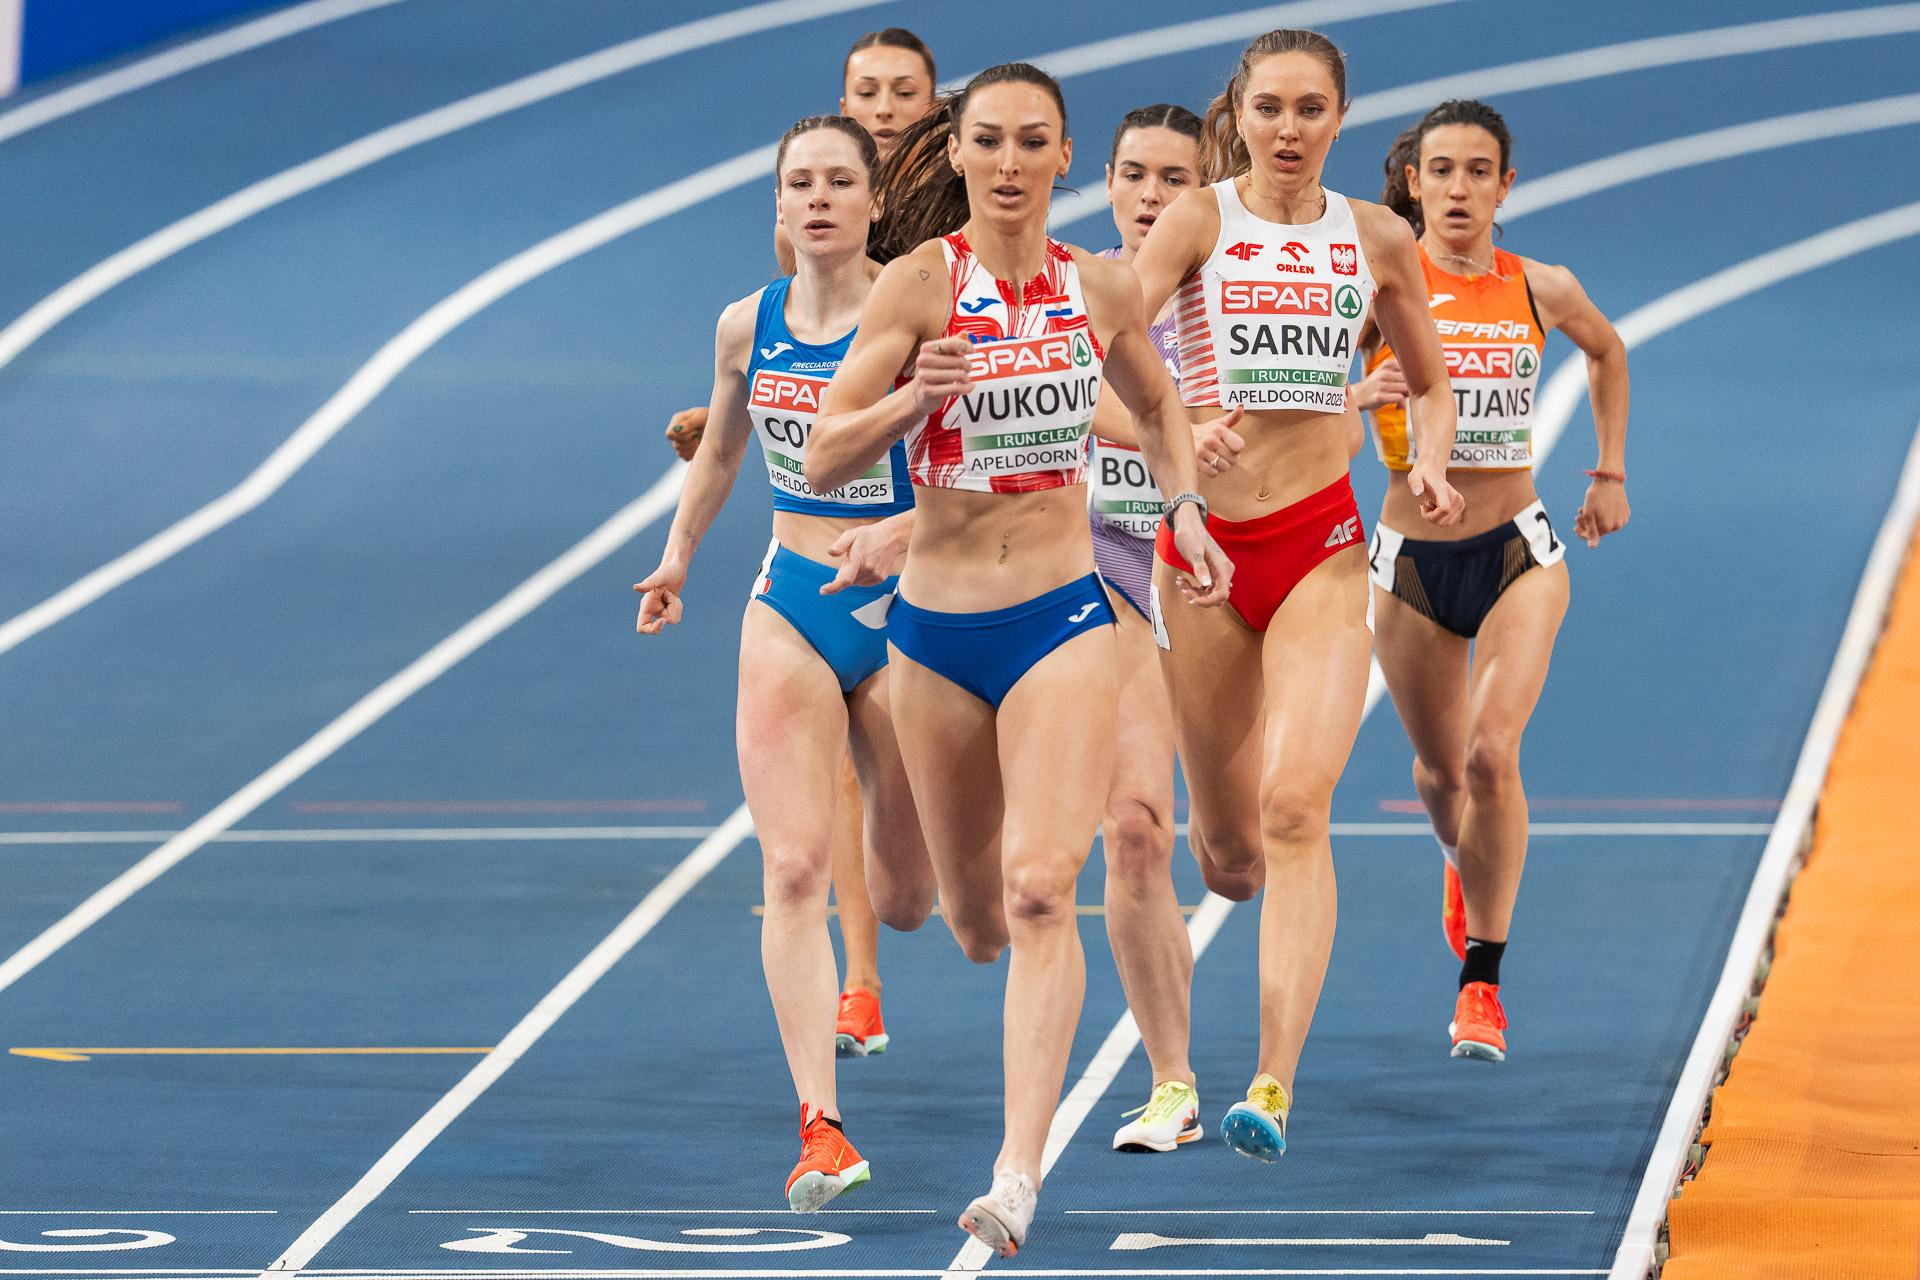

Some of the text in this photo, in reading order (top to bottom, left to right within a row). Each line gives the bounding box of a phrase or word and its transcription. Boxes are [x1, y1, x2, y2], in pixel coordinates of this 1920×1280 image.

[1276, 263, 1314, 274] ORLEN
[1224, 285, 1329, 311] SPAR
[1433, 319, 1530, 339] SPAÑA
[1229, 324, 1349, 359] SARNA
[965, 341, 1071, 378] SPAR
[1251, 371, 1255, 381] I
[1258, 371, 1289, 382] RUN
[962, 376, 1098, 423] VUKOVIC
[1228, 390, 1343, 407] APELDOORN 2025
[764, 417, 813, 449] CO
[996, 436, 1001, 447] I
[1004, 433, 1038, 446] RUN
[971, 448, 1077, 471] APELDOORN
[849, 483, 888, 499] 2025
[1125, 501, 1130, 512] I
[1132, 502, 1159, 513] RUN
[1535, 511, 1559, 554] 2
